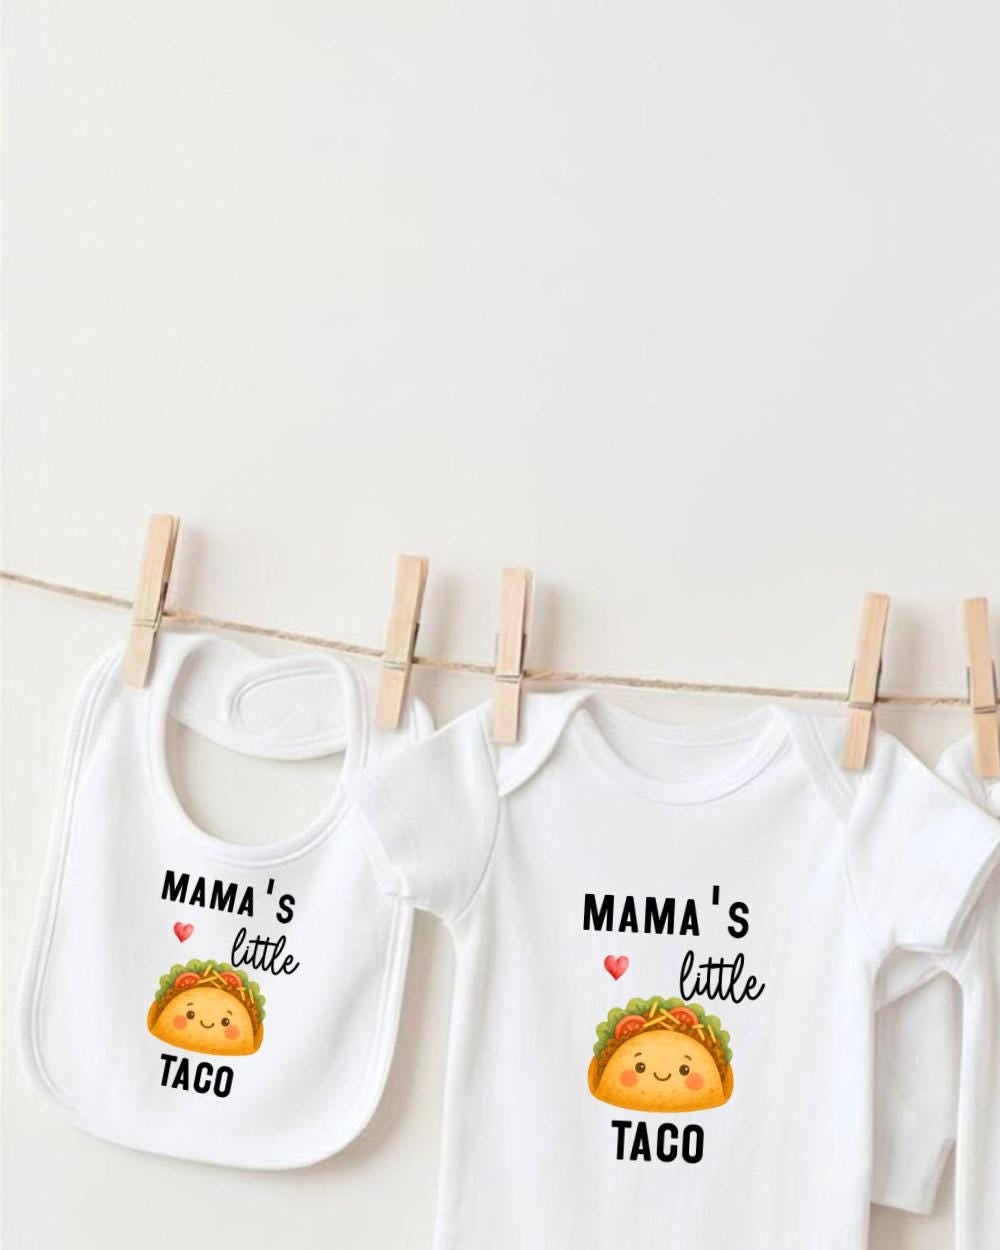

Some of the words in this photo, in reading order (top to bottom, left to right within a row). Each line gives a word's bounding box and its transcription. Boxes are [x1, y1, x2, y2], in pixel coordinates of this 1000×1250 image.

[161, 869, 296, 925] MAMA'S
[583, 884, 750, 939] MAMA'S
[230, 927, 300, 976] little
[679, 949, 766, 1004] little
[159, 1053, 234, 1098] TACO
[611, 1119, 705, 1165] TACO
